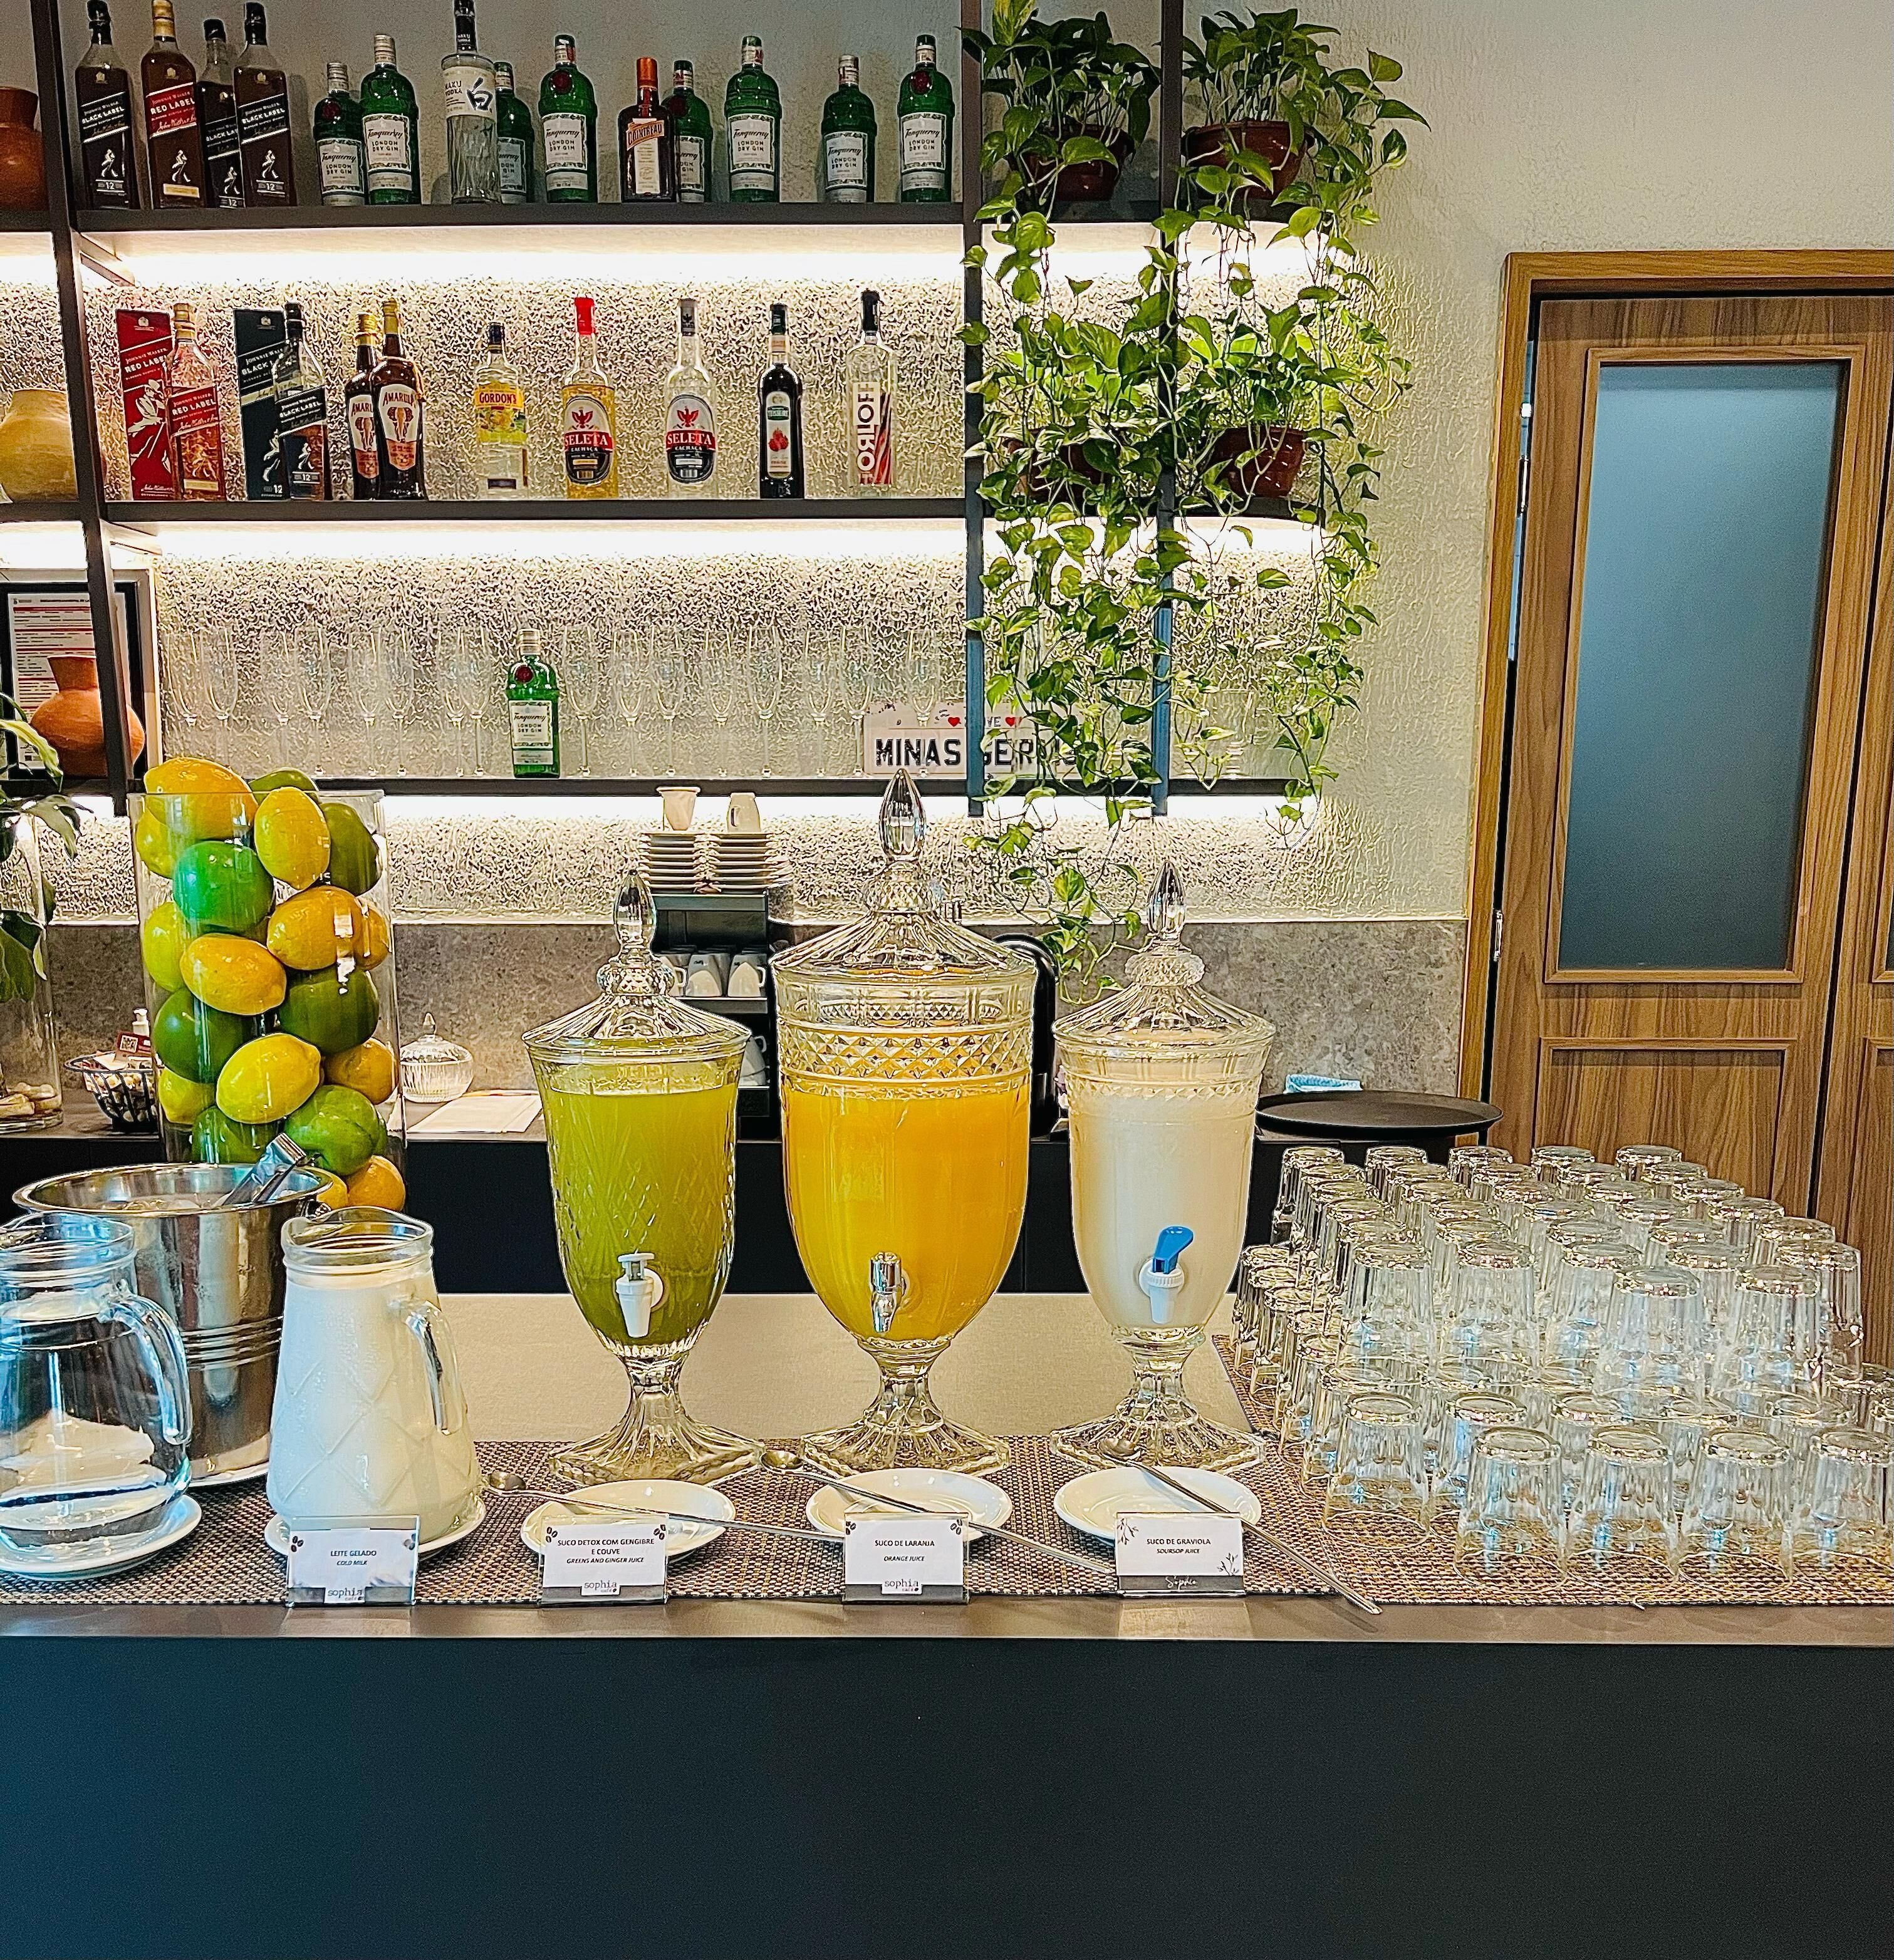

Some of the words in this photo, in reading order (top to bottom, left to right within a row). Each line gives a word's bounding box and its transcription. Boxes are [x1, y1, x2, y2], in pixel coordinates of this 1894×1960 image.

[150, 105, 167, 115] RED
[169, 98, 195, 109] LABEL
[82, 113, 102, 124] BLACK
[103, 106, 125, 117] LABEL
[242, 114, 263, 124] BLACK
[264, 108, 285, 118] LABEL
[206, 132, 226, 142] BLACK
[628, 124, 662, 145] COINTREAU
[125, 363, 142, 373] RED
[242, 361, 268, 375] BLACK
[172, 406, 188, 416] RED
[189, 398, 216, 410] LABEL
[279, 407, 300, 417] BLACK
[301, 401, 321, 411] LABEL
[565, 433, 608, 446] SELETA
[668, 433, 712, 445] SELETA
[274, 485, 282, 494] 12
[876, 739, 961, 766] MINAS
[584, 1580, 617, 1590] sophia
[885, 1579, 918, 1589] sophia
[328, 1587, 362, 1599] sophia
